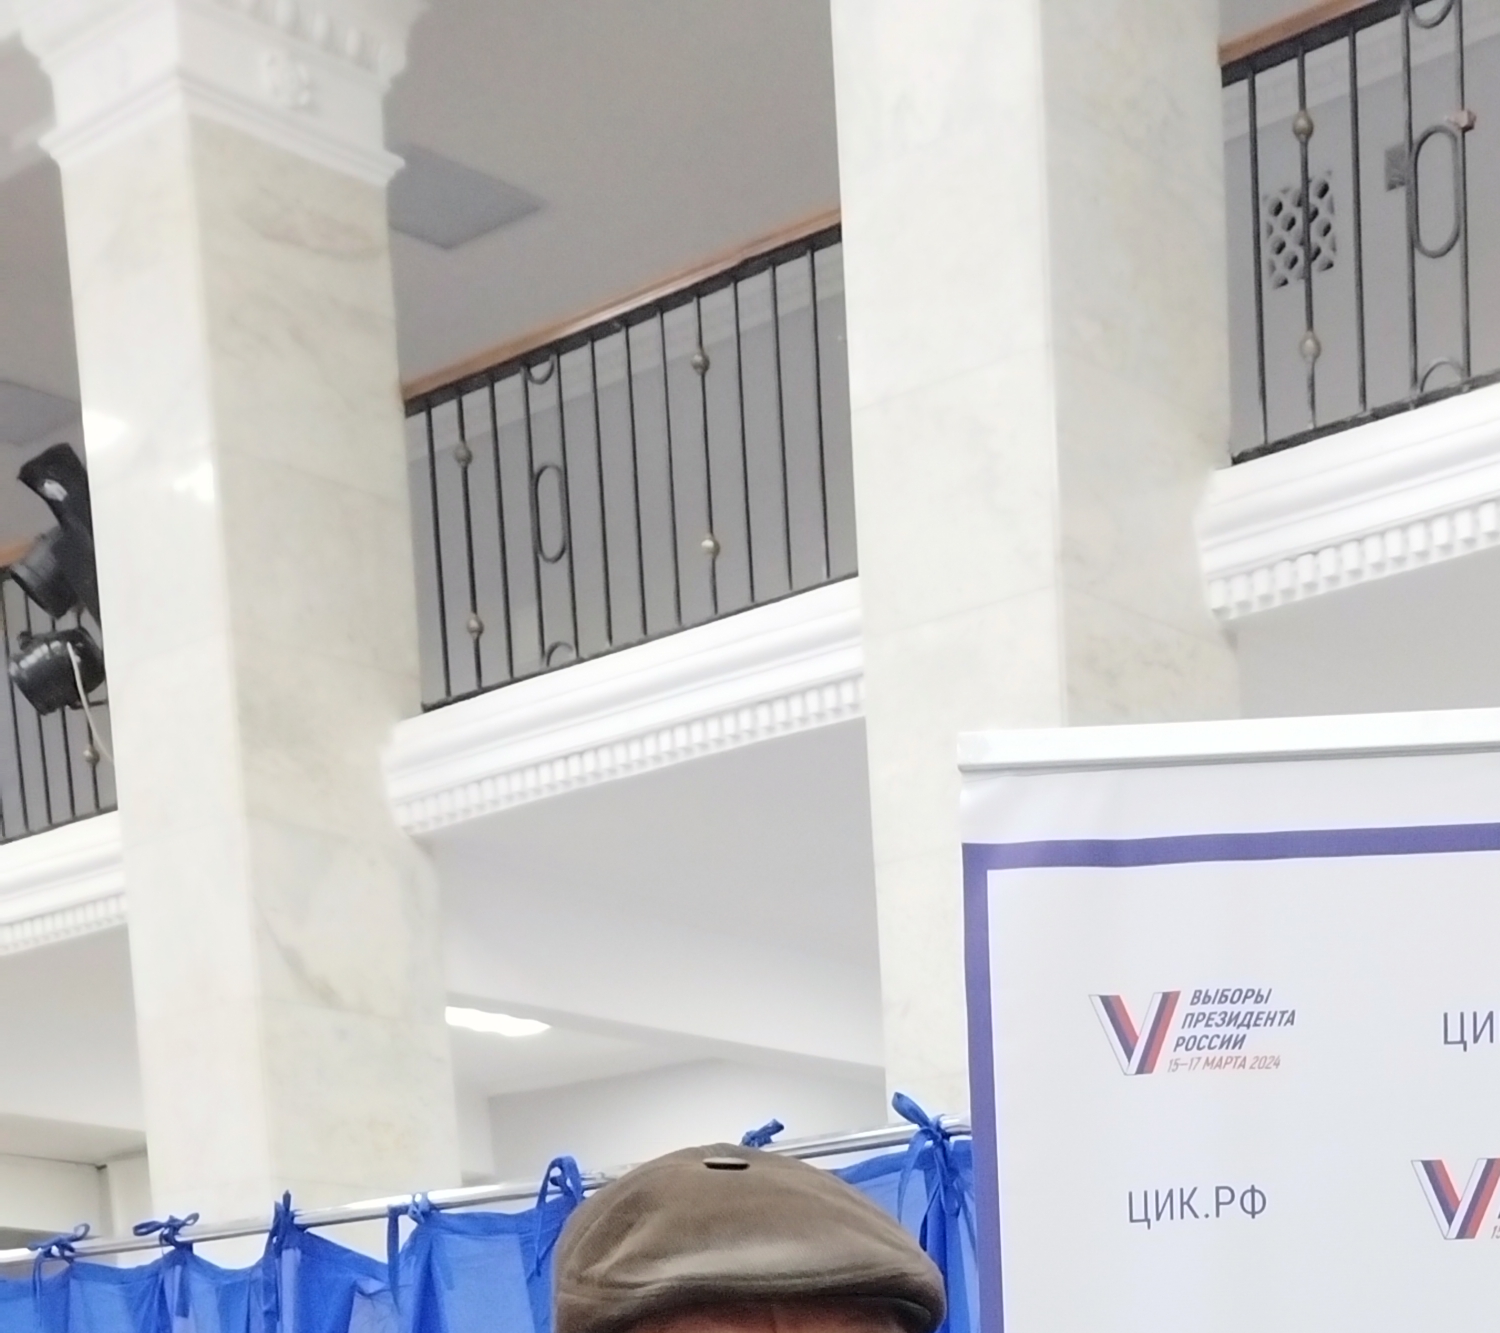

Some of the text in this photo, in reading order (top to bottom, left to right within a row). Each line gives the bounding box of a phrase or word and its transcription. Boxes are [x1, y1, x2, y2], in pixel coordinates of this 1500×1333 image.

[1190, 988, 1272, 1006] ВЫБОРЫ
[1181, 1009, 1296, 1030] ПРЕЗИДЕНТА
[1173, 1033, 1247, 1052] РОССИИ
[1202, 1055, 1247, 1071] МАРТА
[1249, 1055, 1282, 1070] 2024
[1128, 1184, 1267, 1230] ЦИК.РФ
